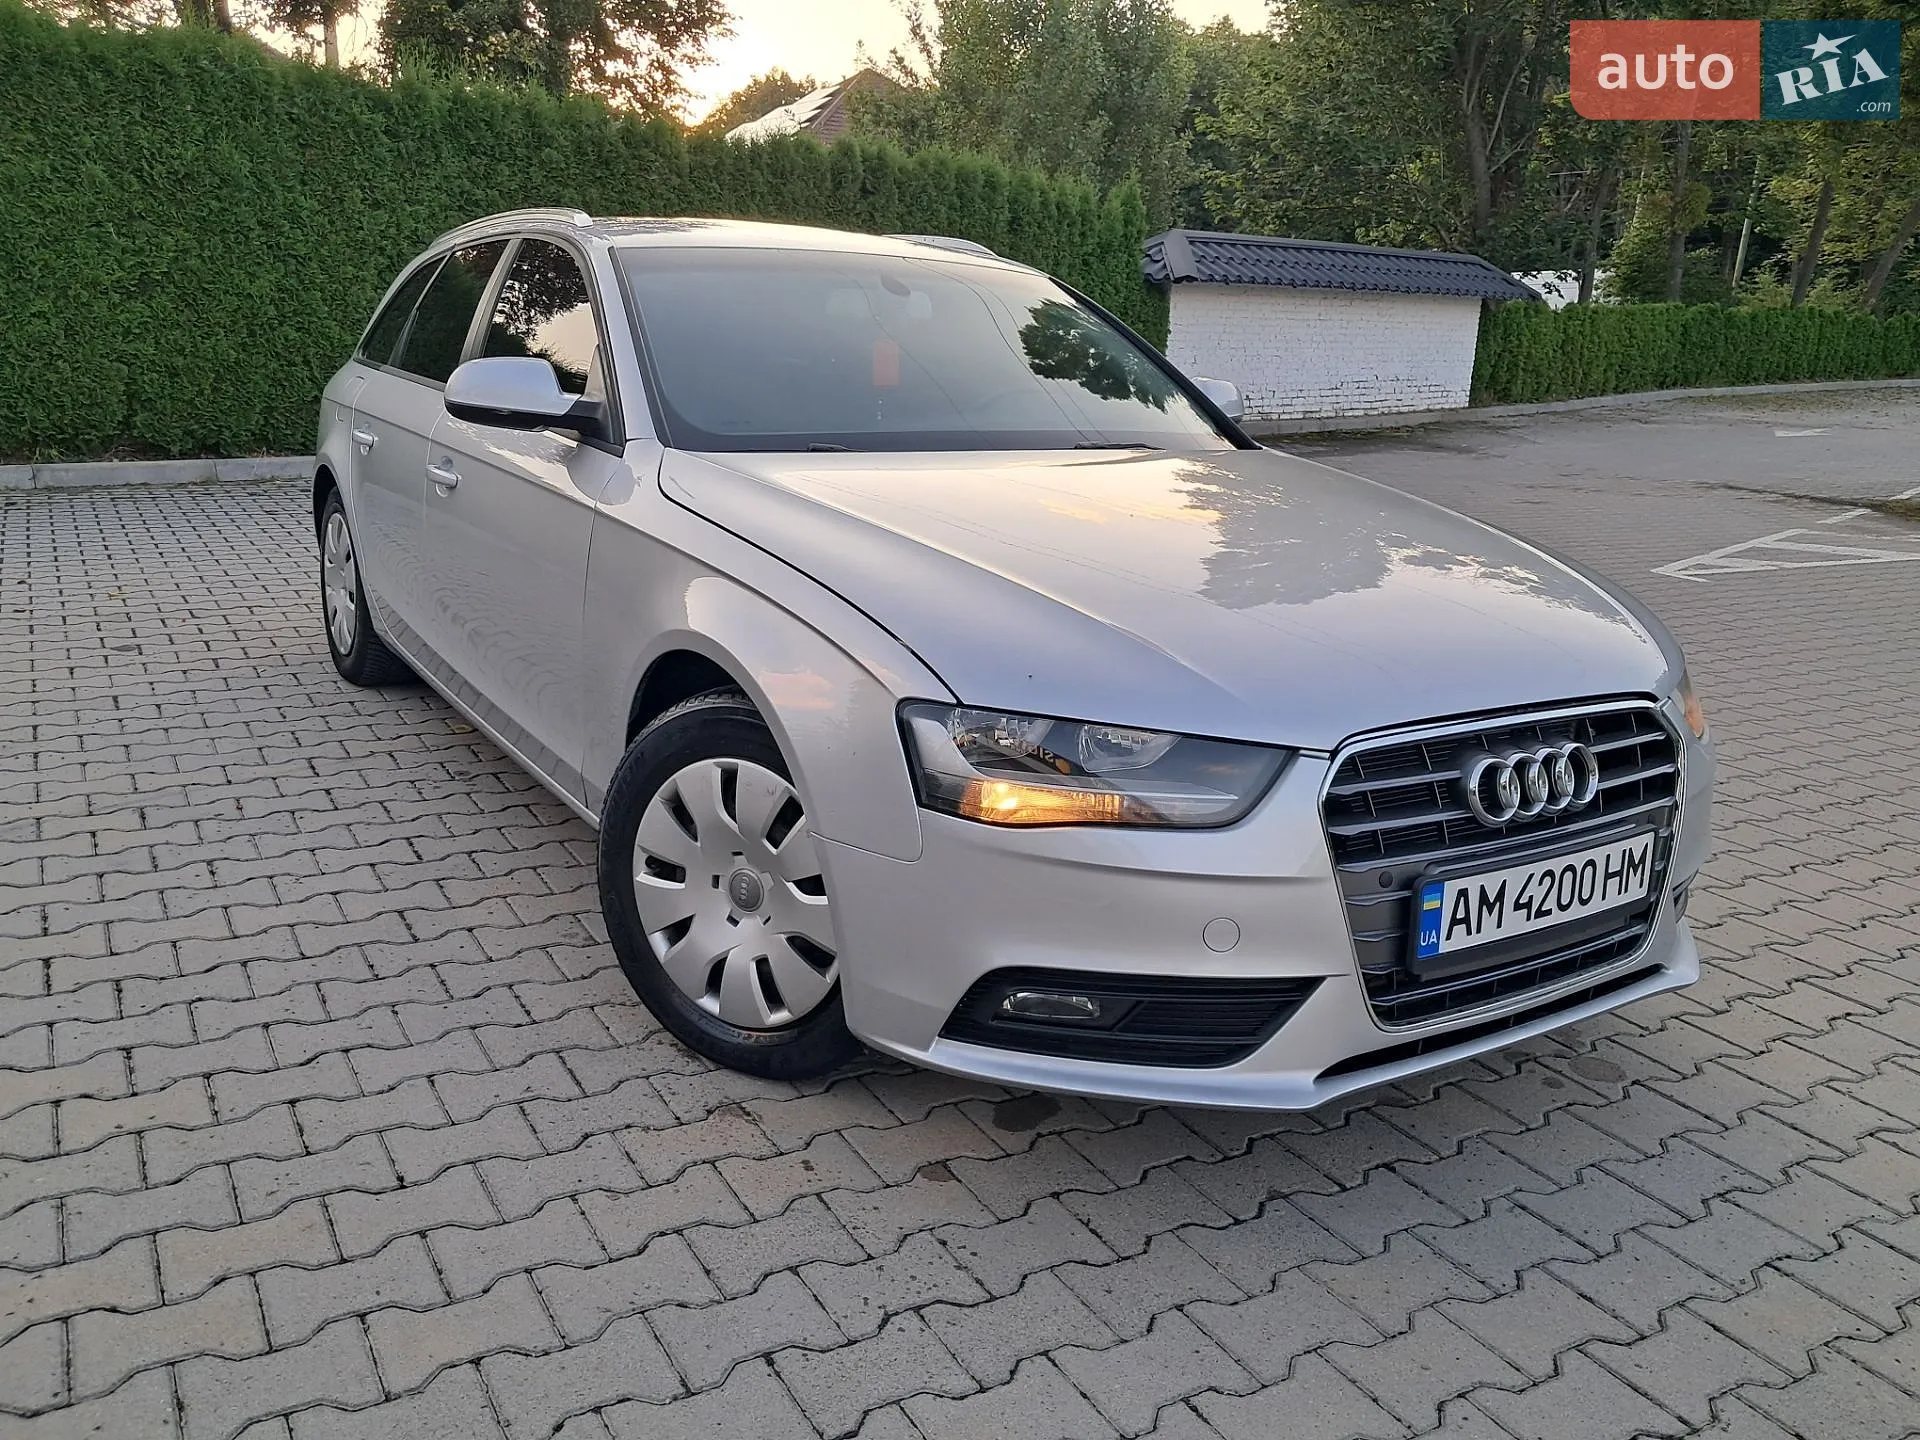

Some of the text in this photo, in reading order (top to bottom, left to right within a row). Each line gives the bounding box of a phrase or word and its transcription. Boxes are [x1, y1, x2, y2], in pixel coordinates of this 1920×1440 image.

[1445, 842, 1649, 941] AM 4200 HM
[1420, 929, 1438, 946] UA
